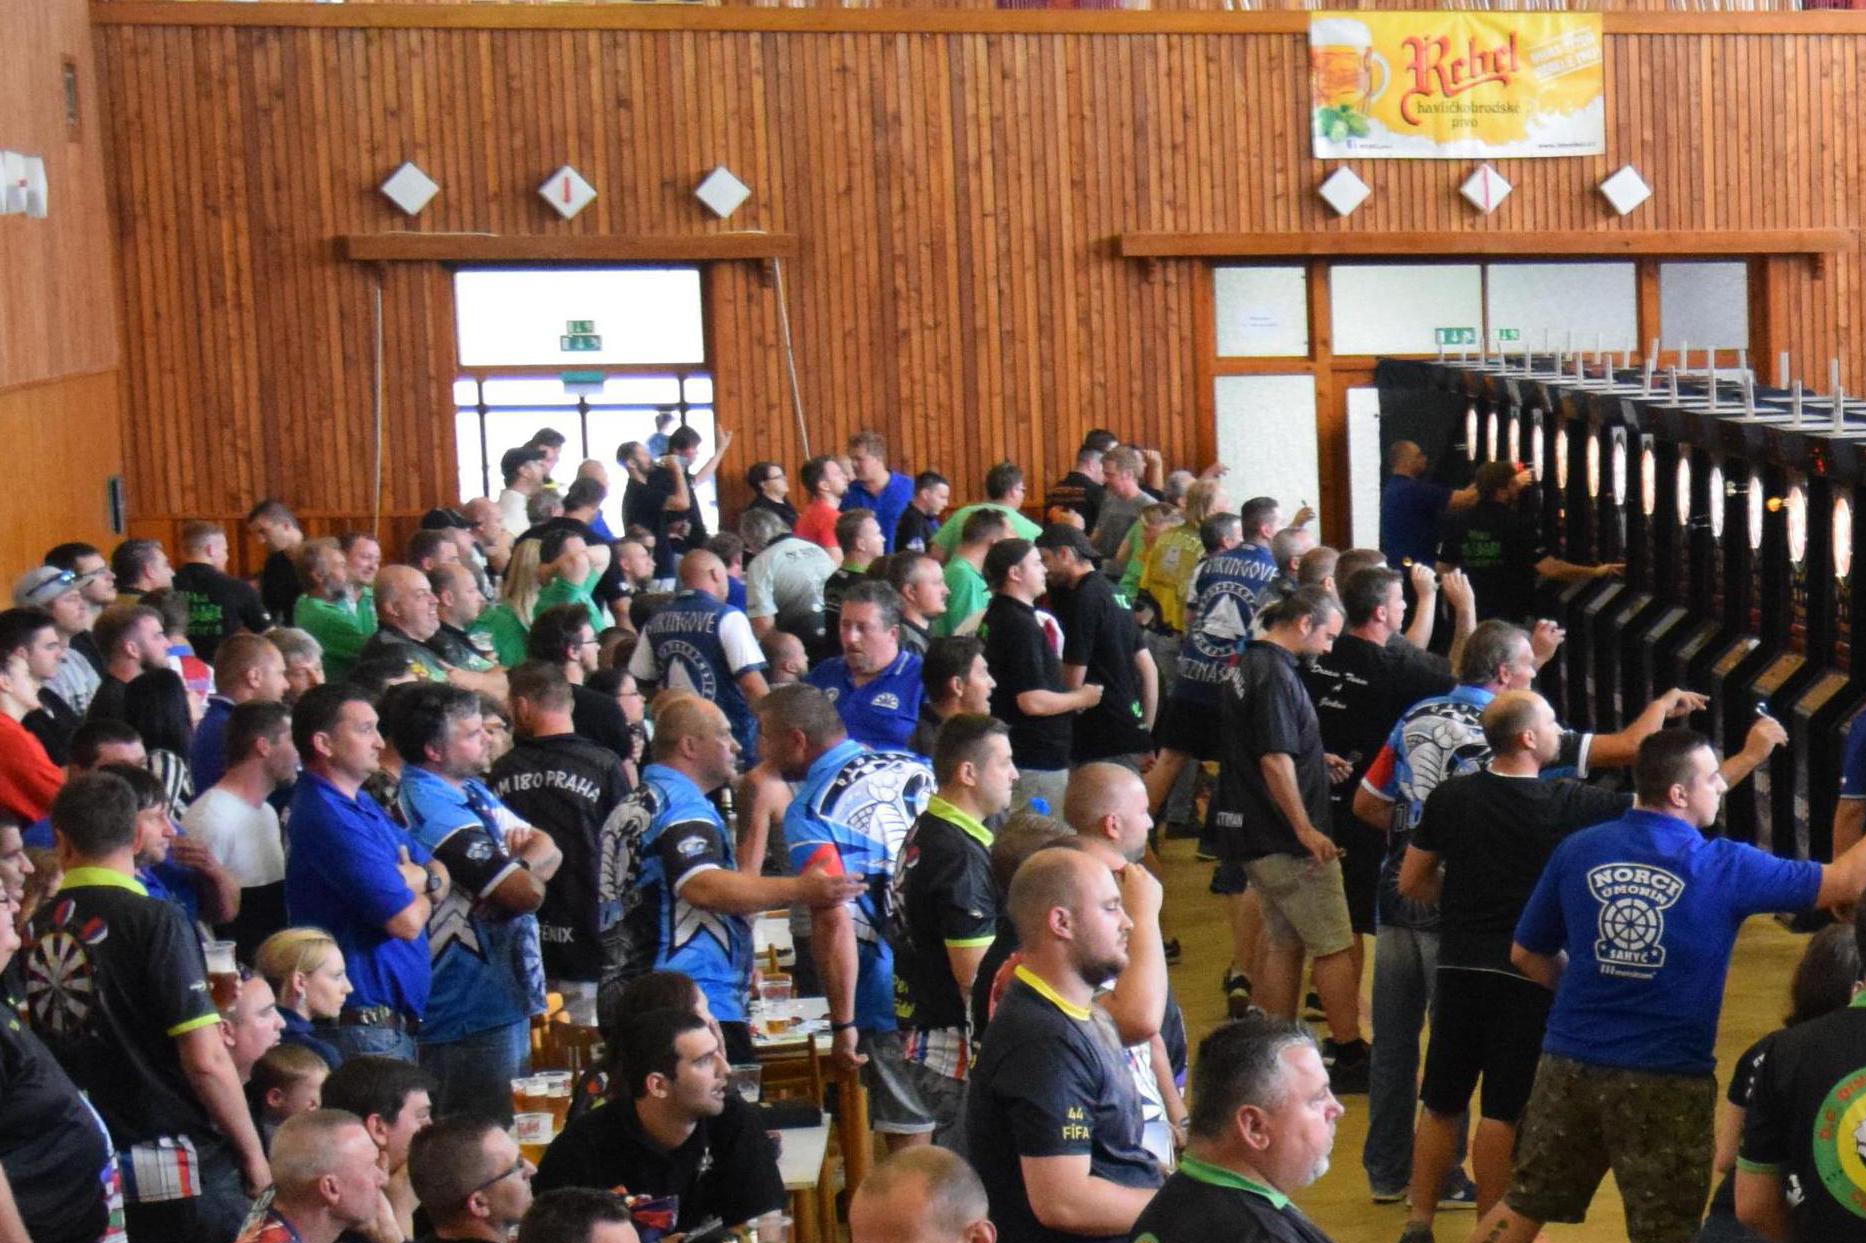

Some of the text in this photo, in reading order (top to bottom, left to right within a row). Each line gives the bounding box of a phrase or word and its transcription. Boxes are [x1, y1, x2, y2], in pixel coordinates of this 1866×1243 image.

[1401, 32, 1519, 105] Rebel
[513, 771, 543, 792] 180
[545, 770, 601, 803] PRAHA
[1593, 867, 1680, 897] NORCI
